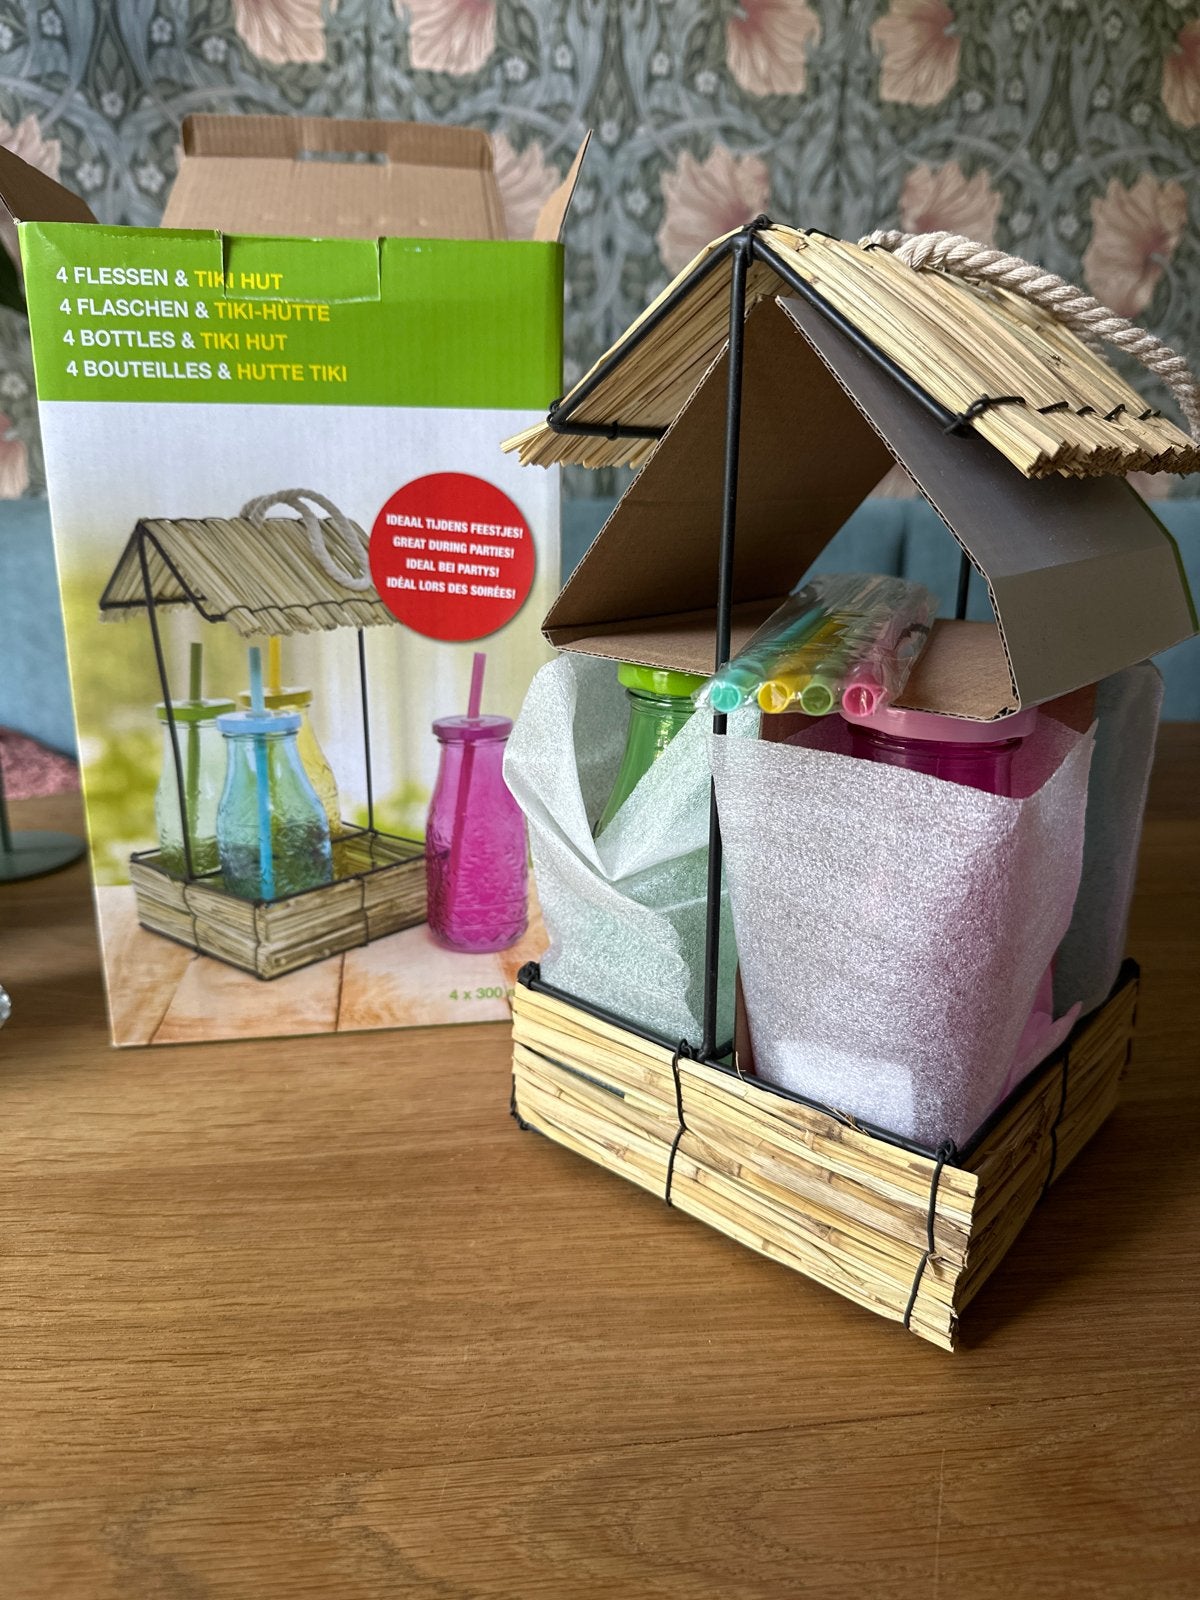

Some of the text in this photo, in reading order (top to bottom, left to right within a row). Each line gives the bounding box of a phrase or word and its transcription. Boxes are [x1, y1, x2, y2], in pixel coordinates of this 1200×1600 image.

[56, 266, 283, 290] 4 FLESSEN & TIKI HUT
[59, 298, 330, 322] 4 FLASCHEN & TIKI-HÜTTE
[63, 330, 288, 351] 4 BOTTLES & TIKI HUT
[66, 360, 347, 382] 4 BOUTEILLES & HUTTE TIKI
[386, 513, 523, 539] IDEAAL TIJDENS FEESTJES!
[393, 536, 515, 559] GREAT DURING PARTIES!
[406, 558, 500, 578] IDEAL BEI PARTYS!
[386, 575, 516, 600] IDÉAL LORS DES SOIRÉES!
[449, 989, 459, 1001] 4
[476, 987, 503, 999] 300
